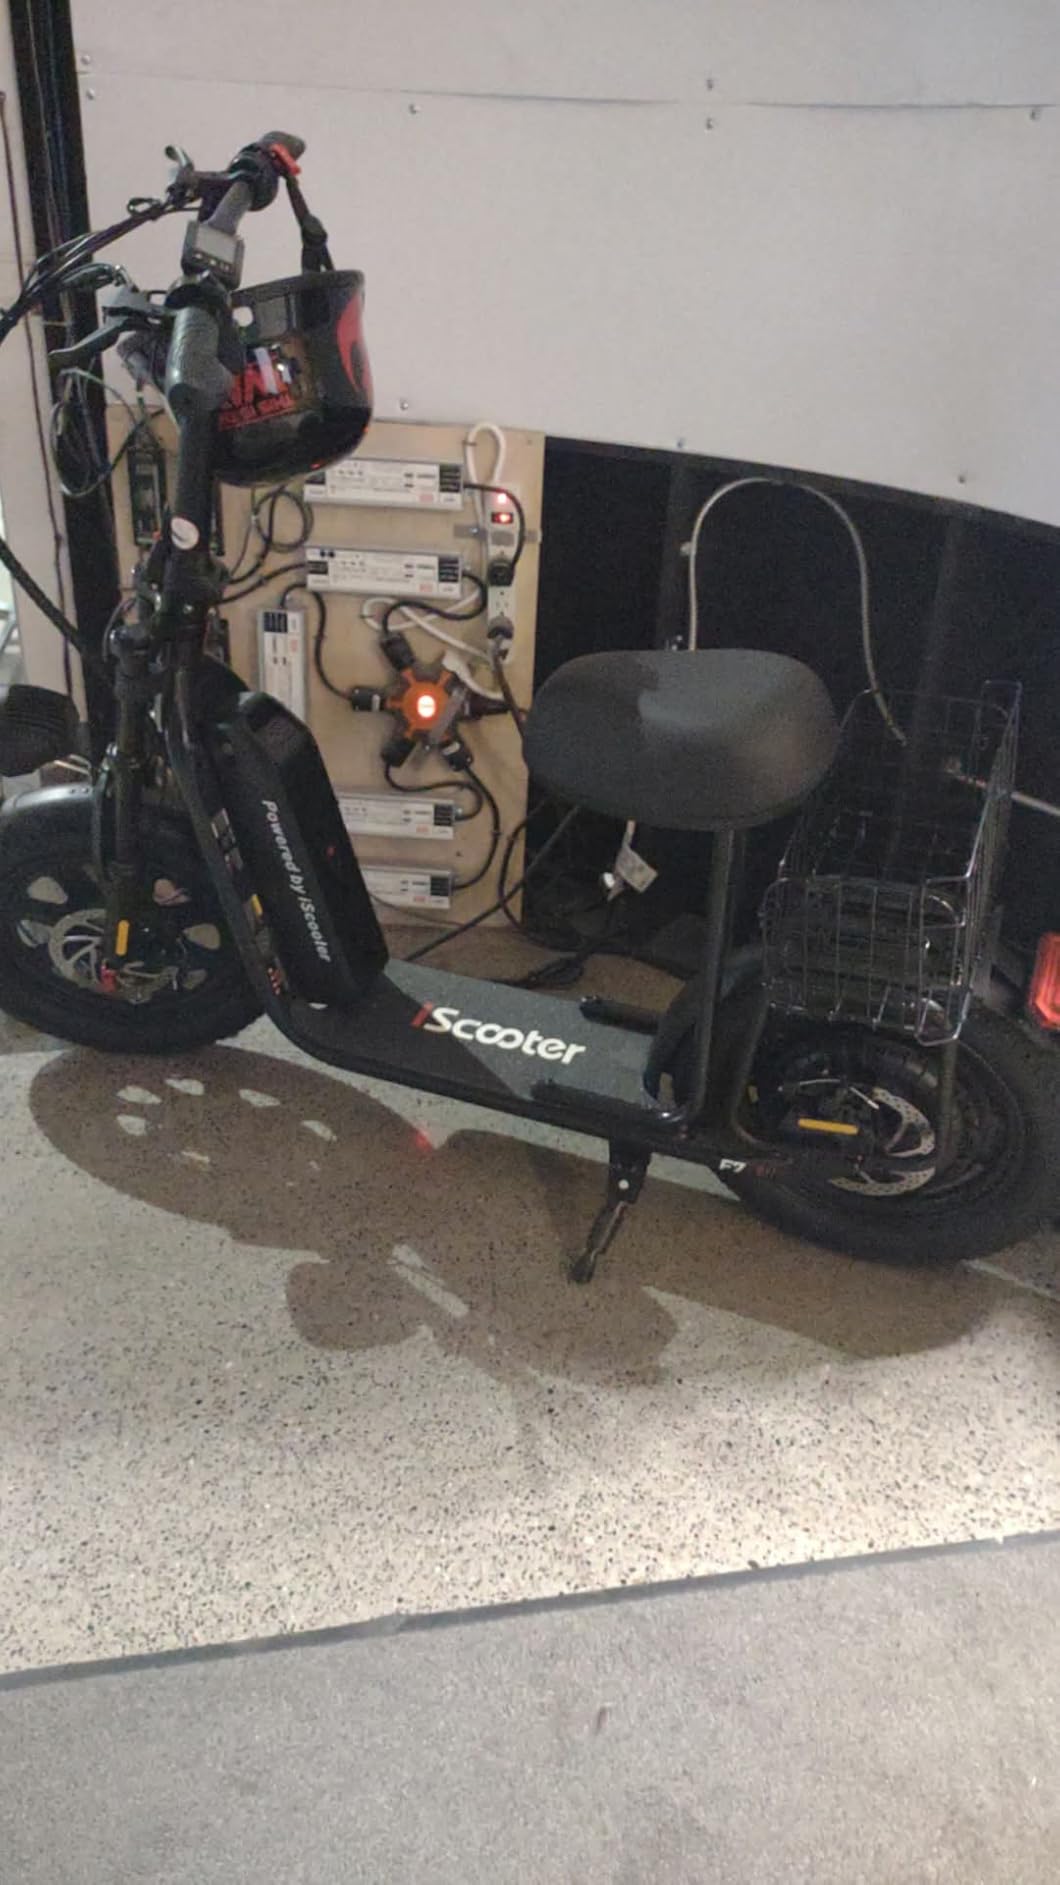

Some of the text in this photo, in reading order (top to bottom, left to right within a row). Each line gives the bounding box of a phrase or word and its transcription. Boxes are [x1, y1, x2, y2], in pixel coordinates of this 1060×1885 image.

[261, 800, 331, 963] Powered by iScooter
[410, 1001, 587, 1065] iScooter
[718, 1158, 747, 1173] F7
